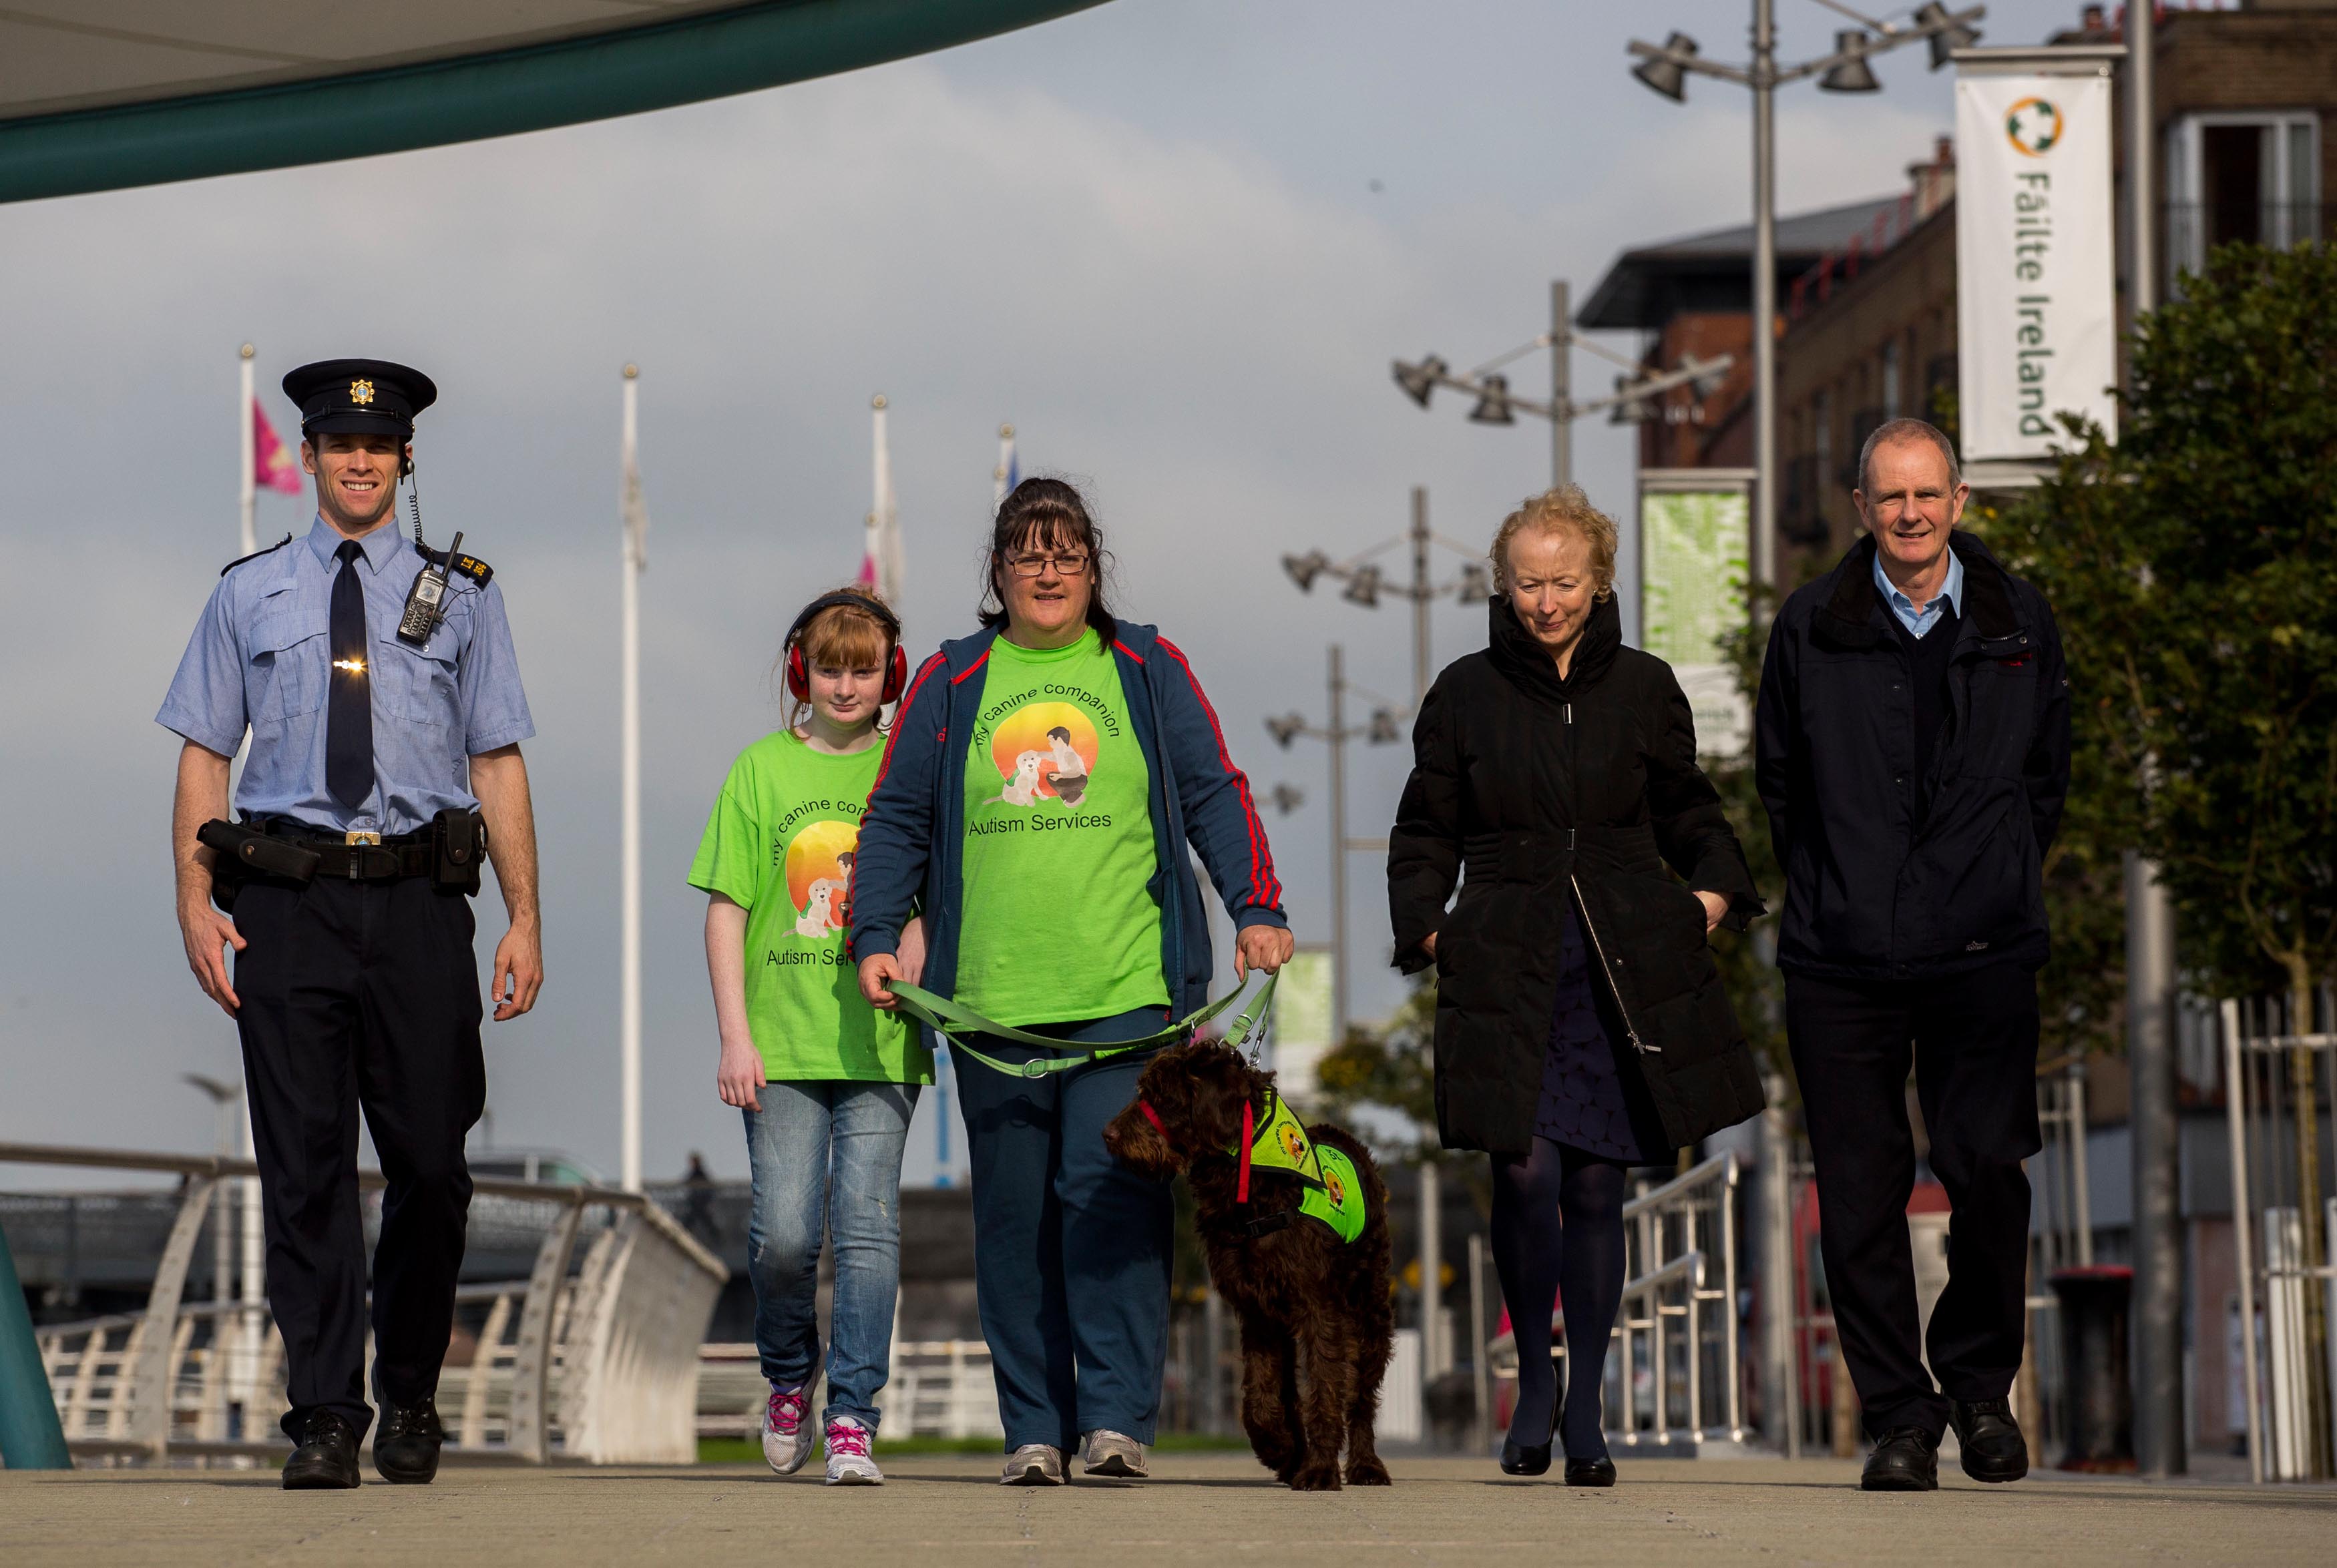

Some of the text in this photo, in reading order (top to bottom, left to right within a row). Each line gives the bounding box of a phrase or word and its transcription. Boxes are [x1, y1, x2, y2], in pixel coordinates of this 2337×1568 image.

[2014, 171, 2054, 437] Fáilte Ireland
[976, 726, 989, 746] my
[984, 688, 1038, 722] canine
[1044, 684, 1120, 738] companion
[773, 838, 783, 866] my
[779, 800, 831, 834] canine
[968, 812, 1111, 836] Autism Services
[767, 949, 816, 967] Autism
